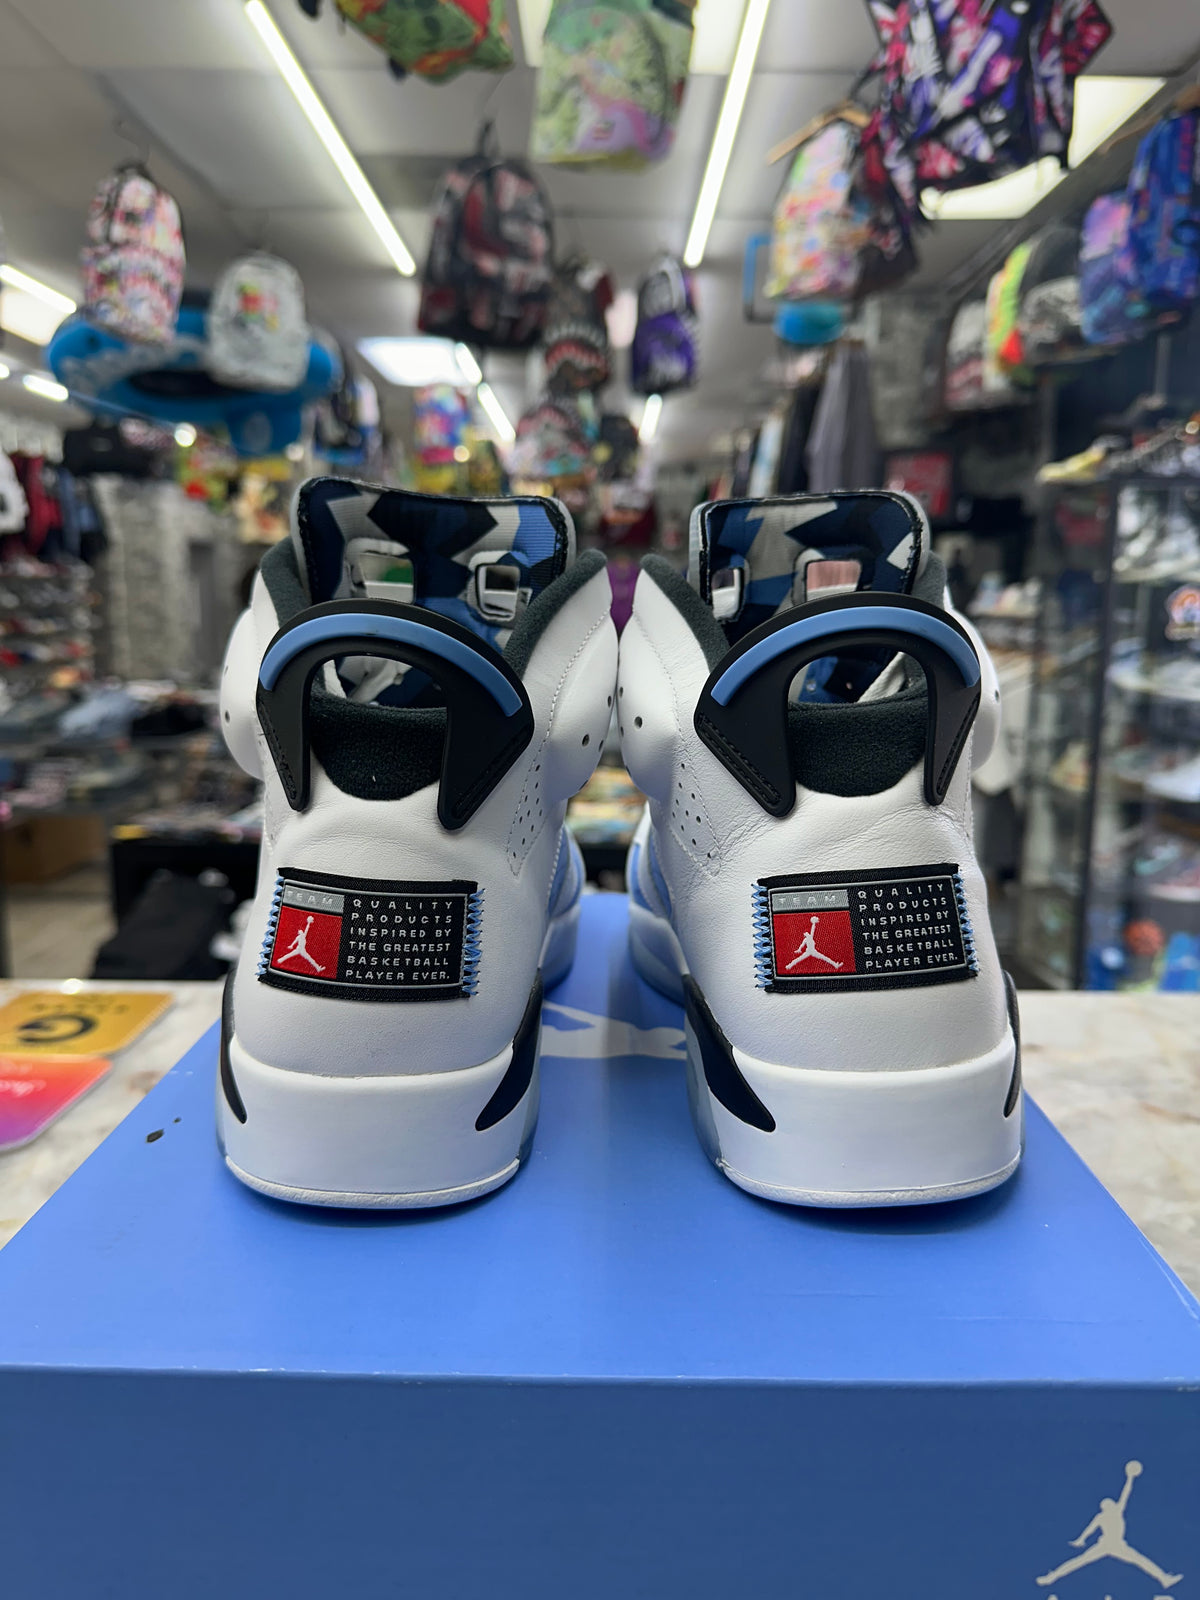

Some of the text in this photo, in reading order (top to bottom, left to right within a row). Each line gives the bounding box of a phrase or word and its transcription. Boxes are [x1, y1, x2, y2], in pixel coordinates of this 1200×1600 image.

[286, 890, 333, 905] TEAM
[858, 884, 944, 899] QUALITY
[353, 899, 452, 910] QUALITY
[778, 894, 837, 905] TEAM
[859, 897, 947, 912] PRODUCTS
[351, 912, 452, 924] PRODUCTS
[861, 911, 949, 926] INSPIRED BY
[350, 926, 451, 938] INSPIRED BY
[862, 925, 951, 941] THE GREATEST
[349, 941, 451, 952] THE GREATEST
[864, 940, 954, 955] BASKETBALL
[347, 955, 449, 966] BASKETBALL
[865, 953, 958, 969] PLAYER EVER.
[345, 969, 450, 980] PLAYER EVER.
